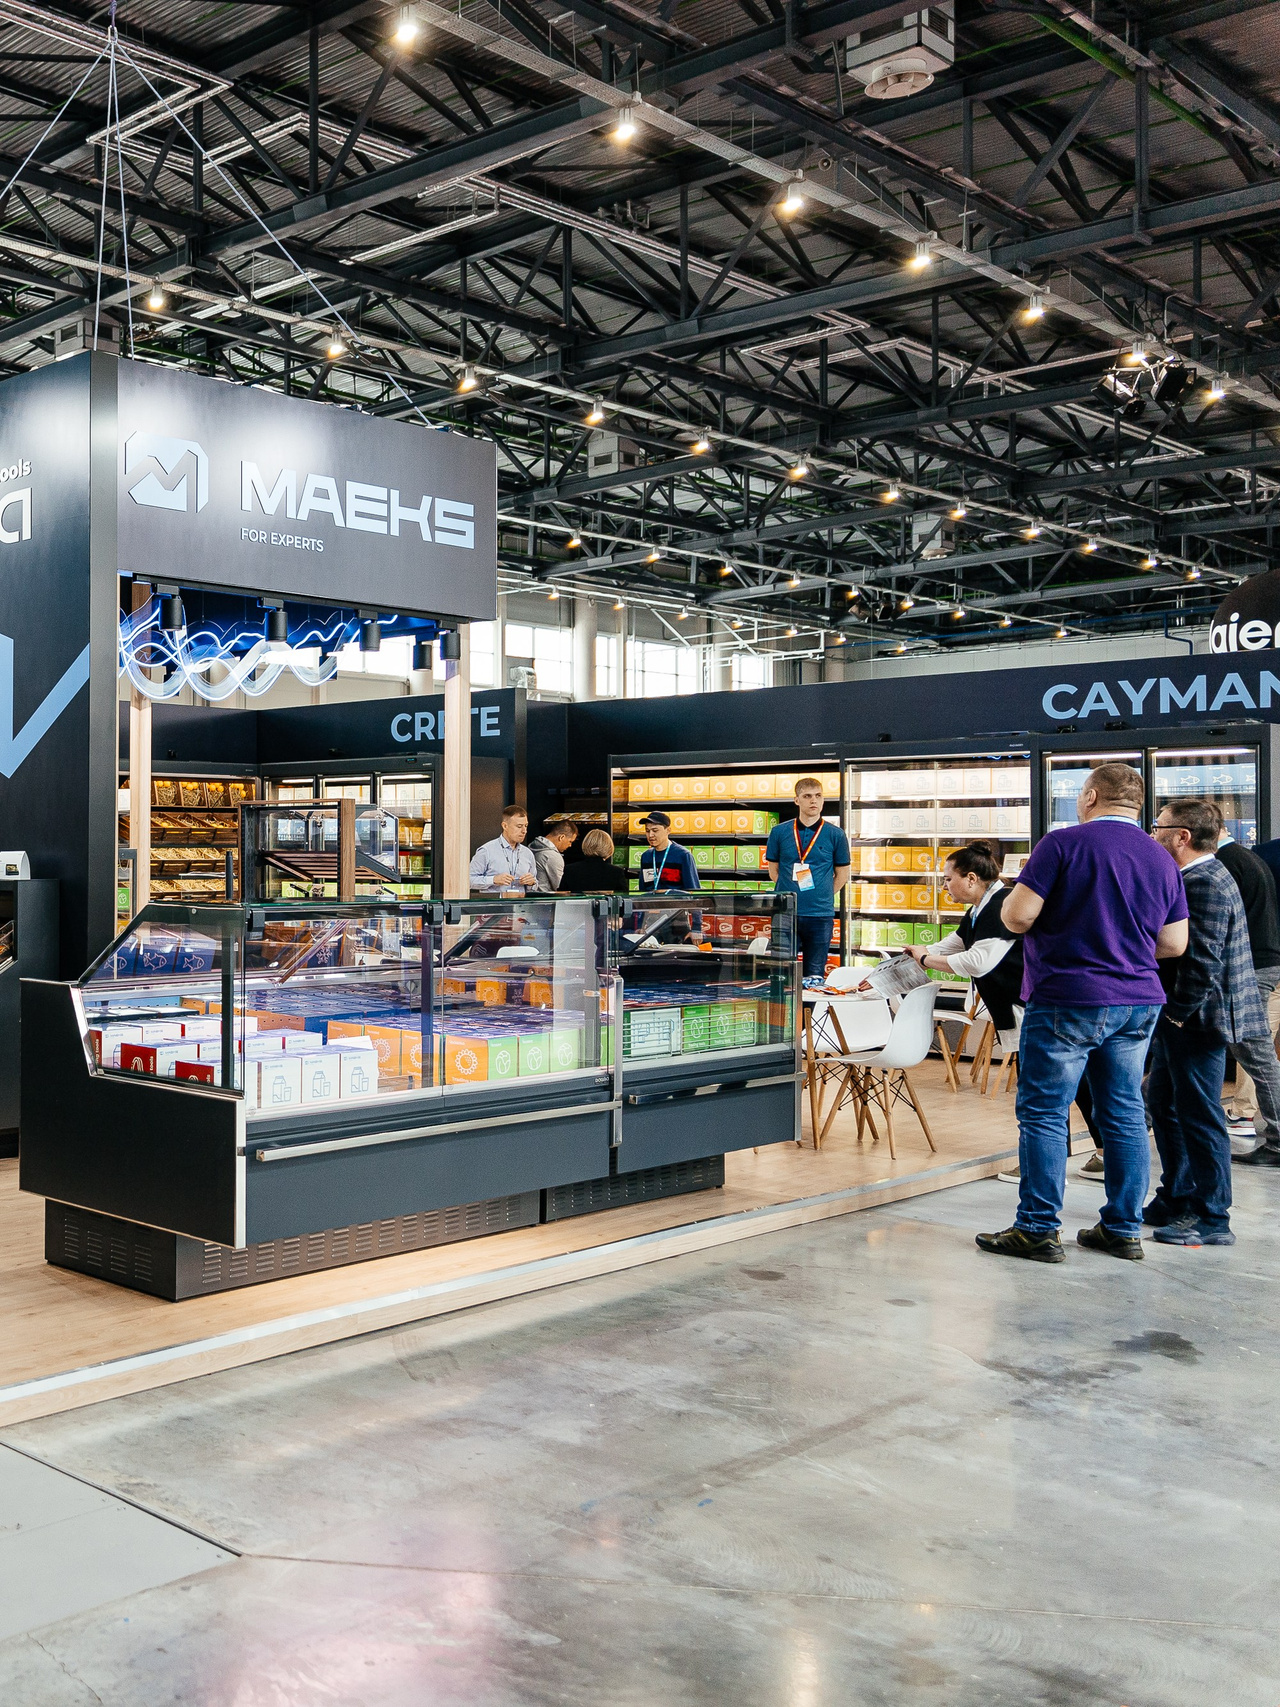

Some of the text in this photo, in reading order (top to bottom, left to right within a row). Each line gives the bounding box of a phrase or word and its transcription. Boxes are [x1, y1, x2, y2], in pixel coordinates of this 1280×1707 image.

[240, 460, 475, 550] MAEKS
[241, 527, 324, 553] FOR EXPERTS
